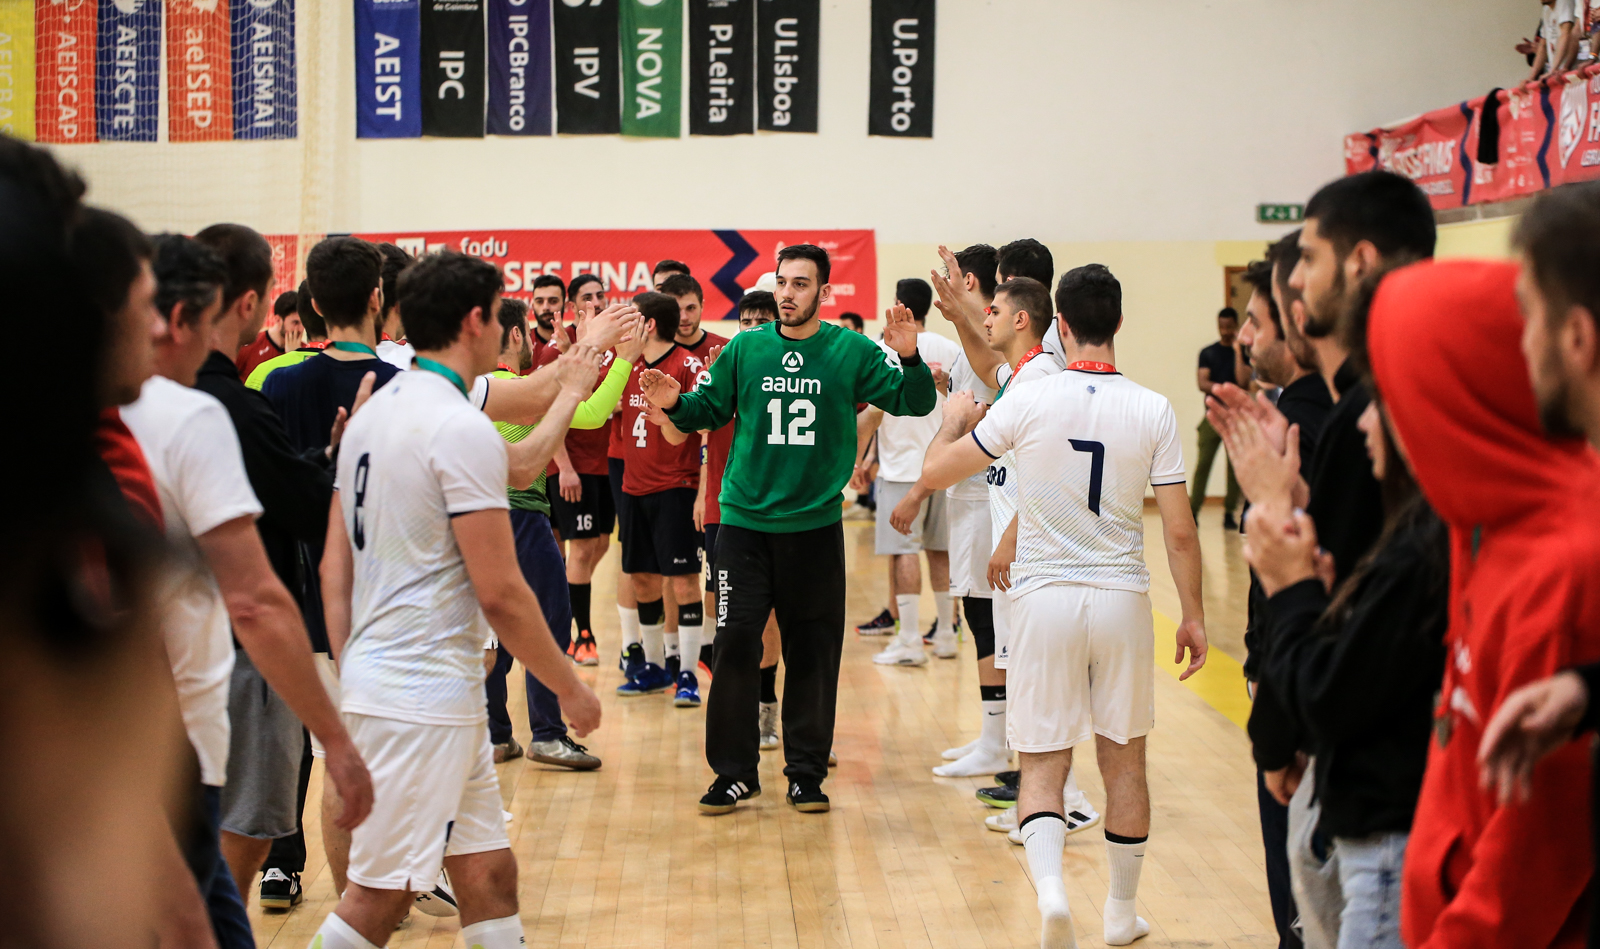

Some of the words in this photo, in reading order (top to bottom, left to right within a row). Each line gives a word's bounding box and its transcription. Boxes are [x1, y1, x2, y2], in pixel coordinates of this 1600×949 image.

[444, 3, 478, 11] Coimbra
[58, 31, 78, 139] AEISCAP
[114, 25, 138, 130] AEISCTE
[186, 28, 212, 128] aeISEP
[252, 22, 275, 128] AEISMAI
[374, 32, 402, 121] AEIST
[438, 51, 465, 99] IPC
[508, 15, 529, 131] IPCBranco
[573, 47, 600, 99] IPV
[635, 28, 663, 119] NOVA
[708, 24, 734, 123] P.Leiria
[772, 18, 799, 126] ULisboa
[891, 18, 919, 132] U.Porto
[460, 236, 508, 257] fadu
[761, 376, 821, 394] aaum
[767, 398, 816, 446] 12
[632, 411, 648, 448] 4
[1068, 438, 1105, 518] 7
[576, 513, 593, 531] 16
[717, 569, 733, 628] Kempa
